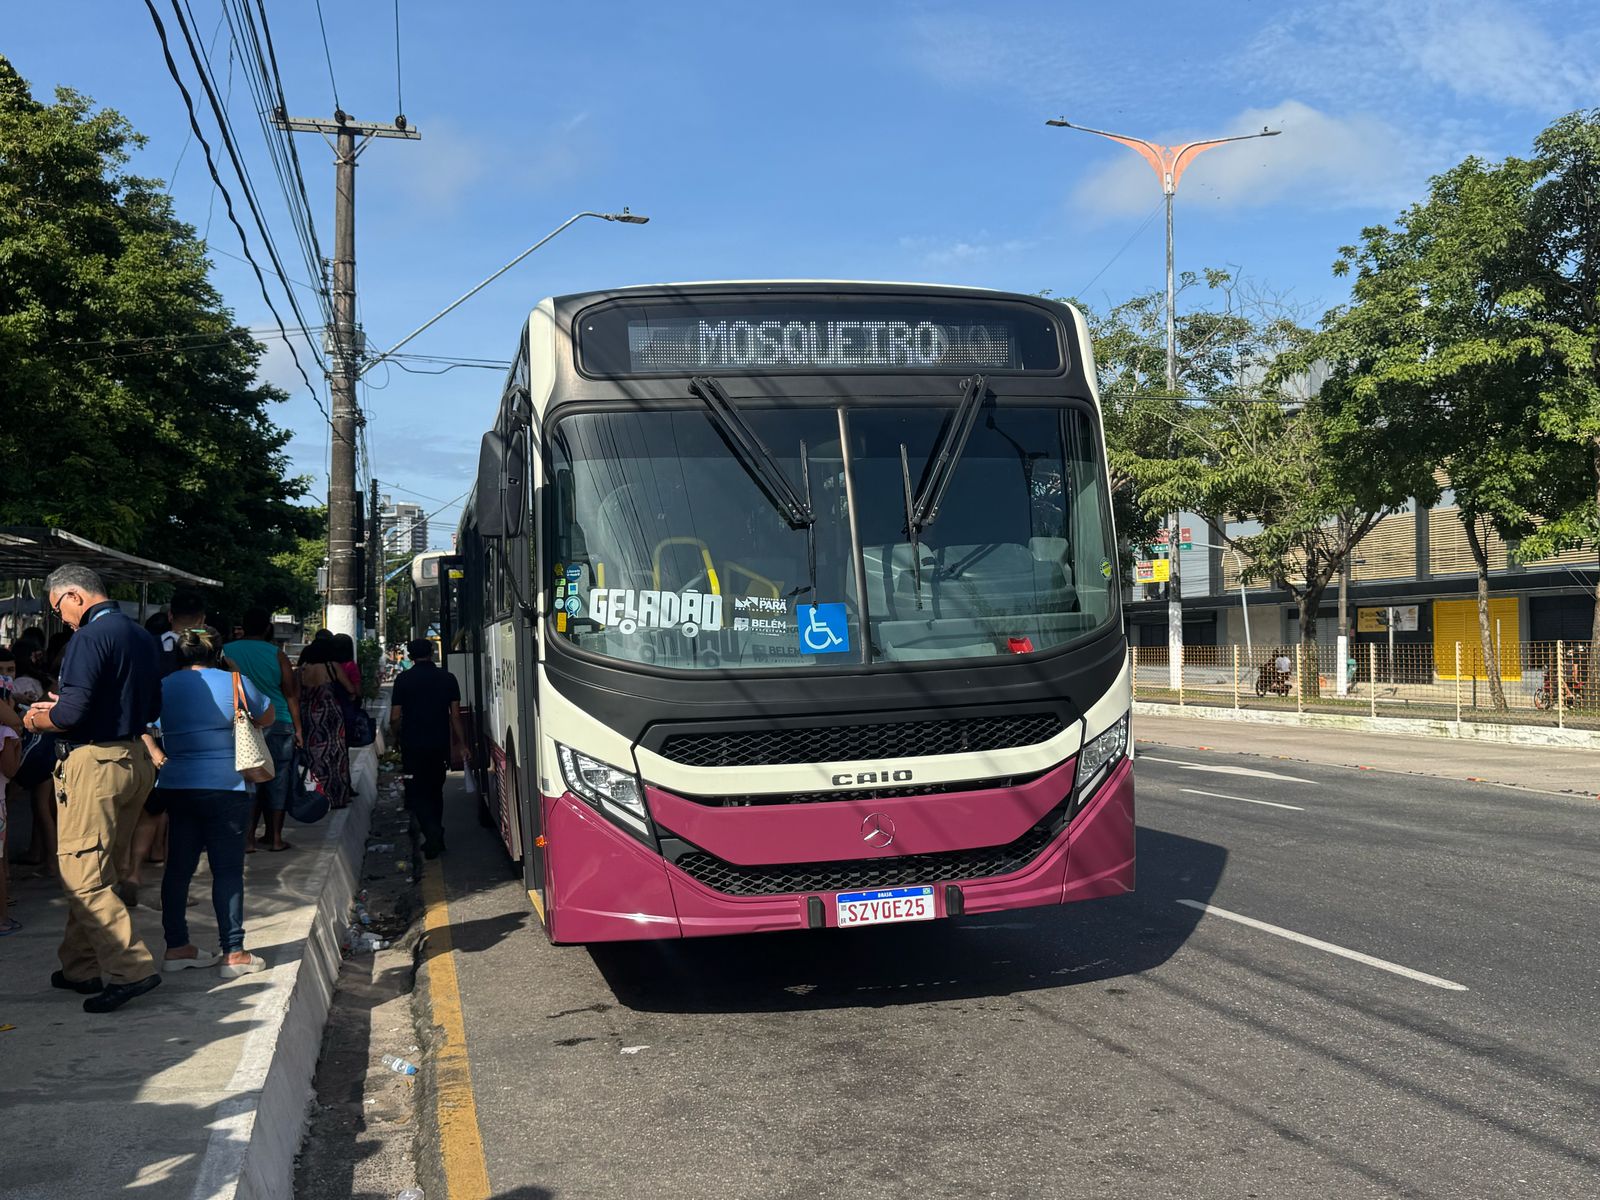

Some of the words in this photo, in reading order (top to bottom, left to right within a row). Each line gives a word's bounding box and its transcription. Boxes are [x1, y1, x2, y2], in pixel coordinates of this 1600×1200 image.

[699, 320, 938, 364] MOSQUEIRO
[588, 588, 722, 637] GELADÃO
[752, 618, 786, 629] BELÉM
[832, 770, 913, 786] CAIO
